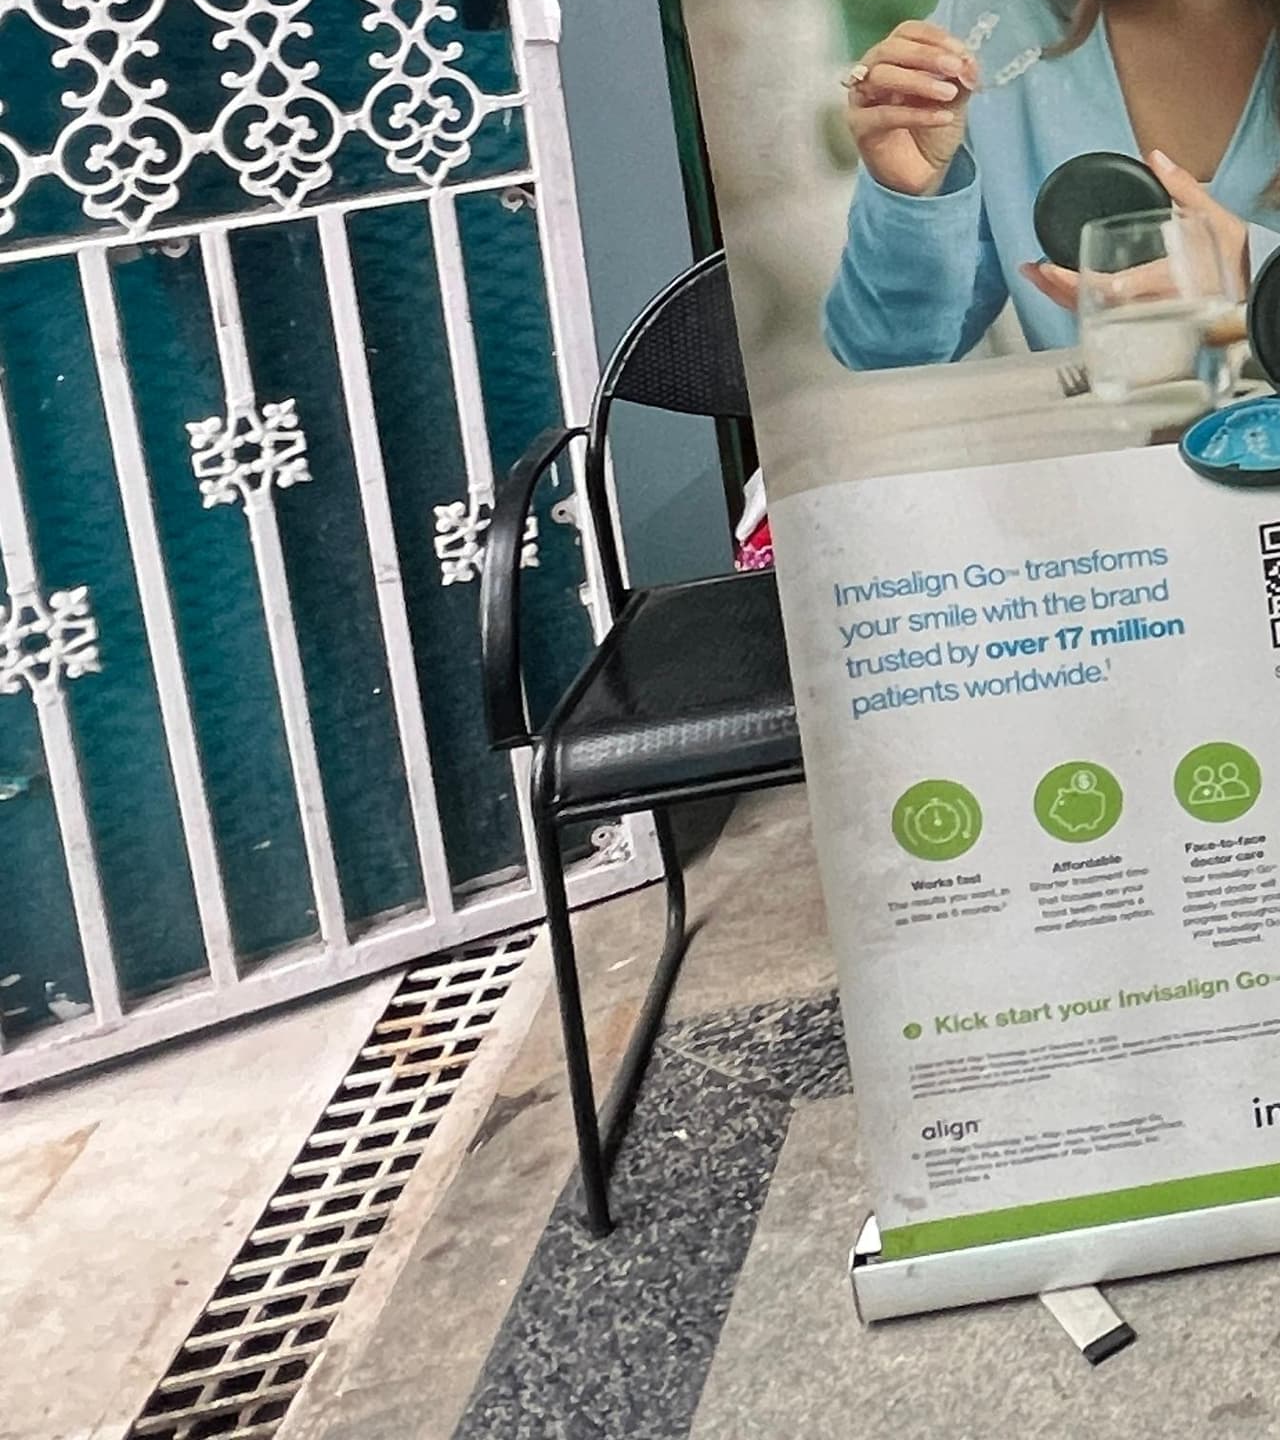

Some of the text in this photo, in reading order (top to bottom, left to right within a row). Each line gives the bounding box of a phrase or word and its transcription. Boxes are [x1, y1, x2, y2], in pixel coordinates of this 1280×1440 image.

[834, 570, 959, 608] Invisalign
[1026, 547, 1168, 581] transforms
[840, 578, 1169, 648] your smile with the brand
[846, 617, 1185, 678] trusted by over 17 million
[852, 679, 960, 720] patients
[934, 1012, 989, 1035] Kick
[995, 1002, 1051, 1028] start
[1057, 995, 1112, 1022] your
[1118, 977, 1230, 1009] Invisalign
